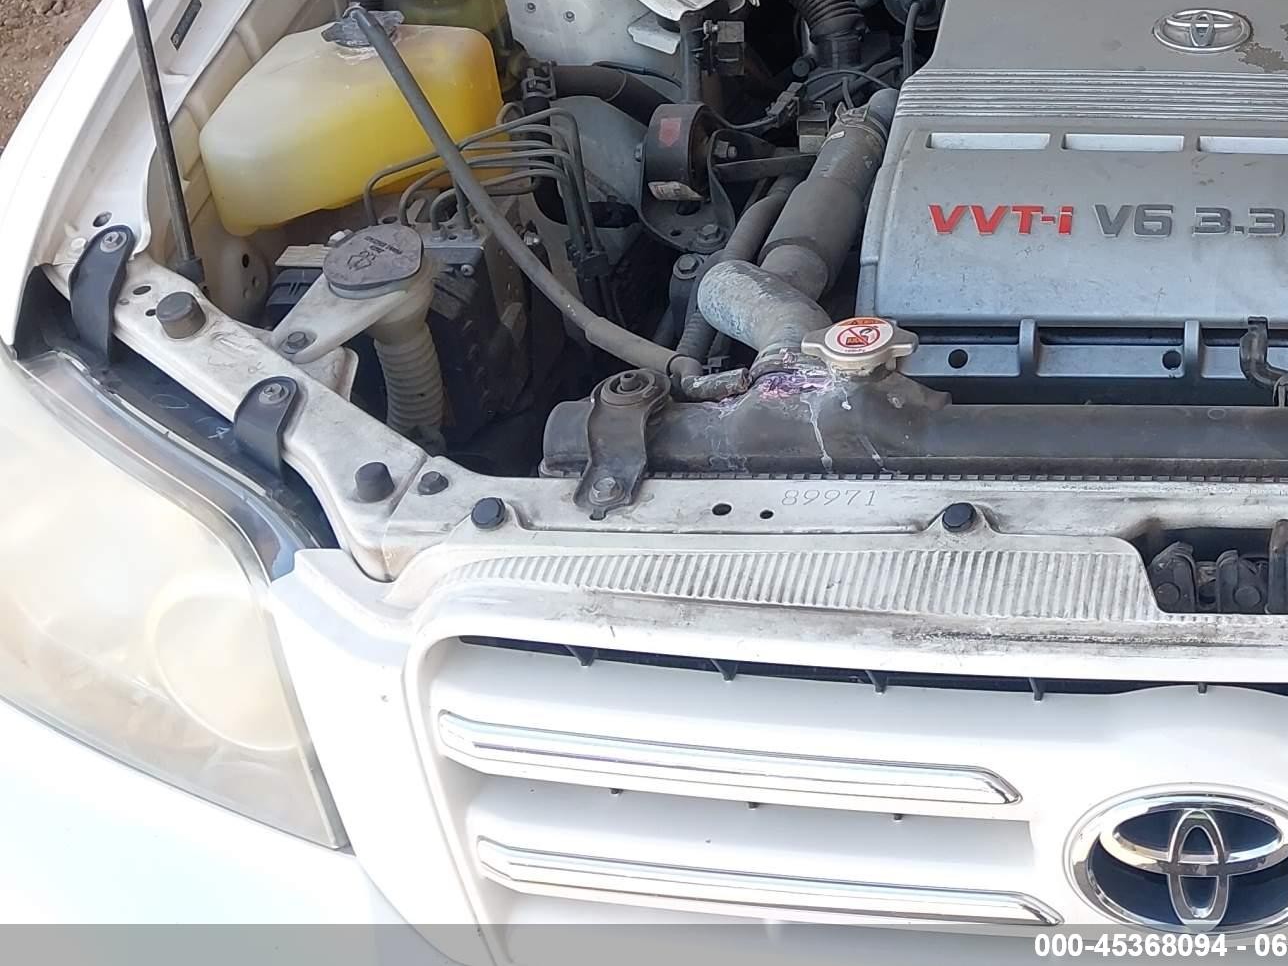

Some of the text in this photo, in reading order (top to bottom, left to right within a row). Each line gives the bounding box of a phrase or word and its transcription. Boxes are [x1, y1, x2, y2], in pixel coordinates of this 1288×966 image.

[928, 204, 1286, 238] VVT-i V6 3.3
[781, 489, 876, 506] 89971
